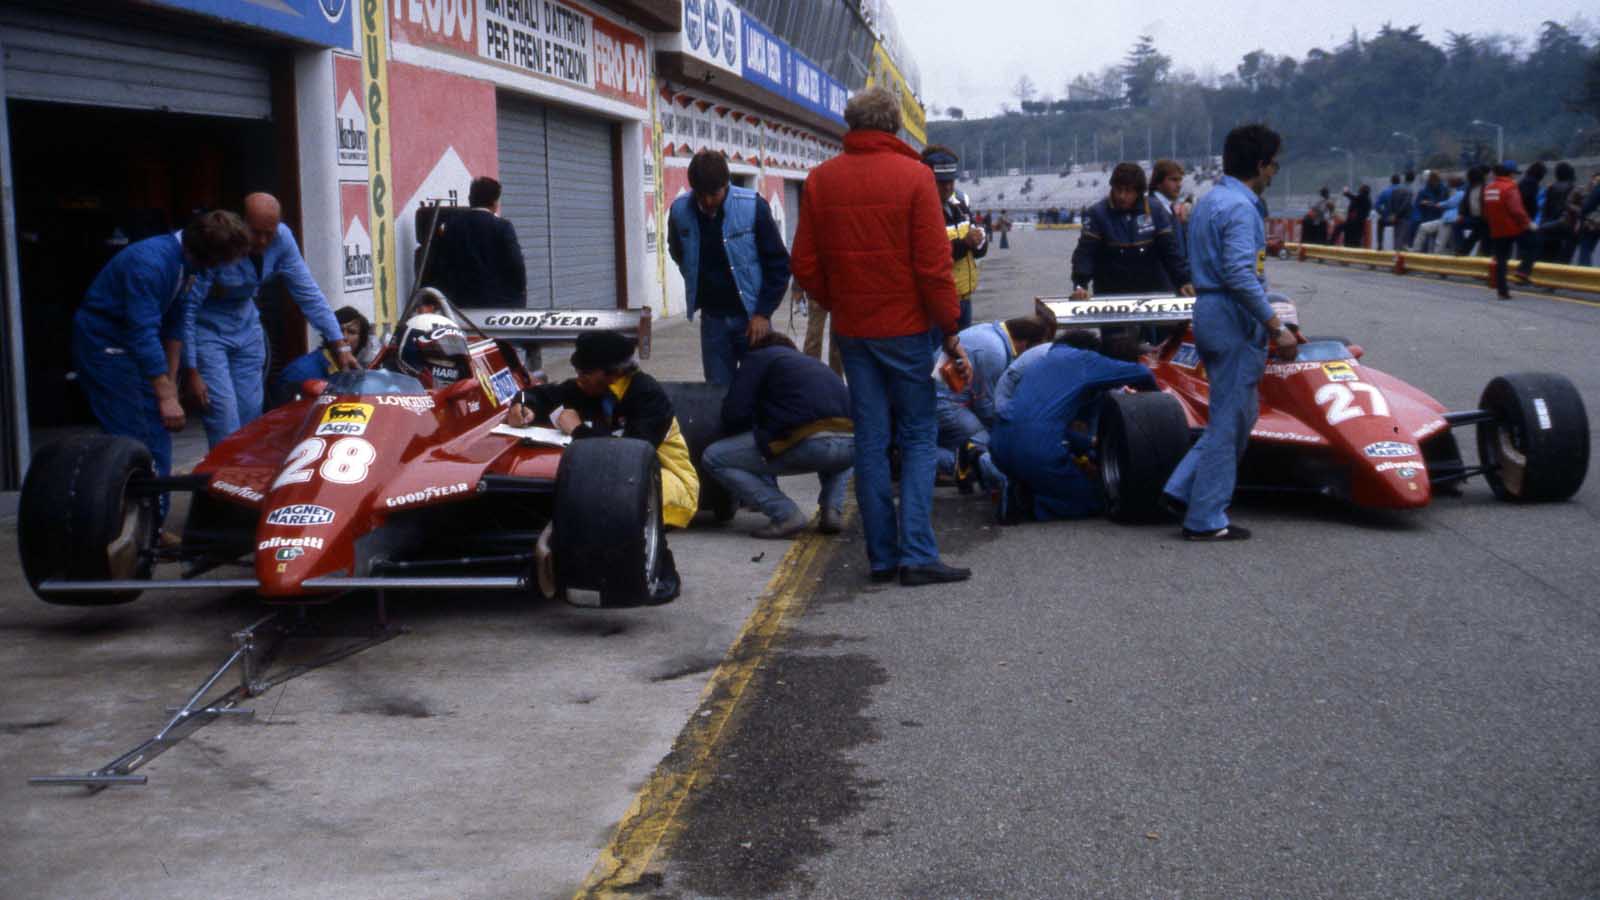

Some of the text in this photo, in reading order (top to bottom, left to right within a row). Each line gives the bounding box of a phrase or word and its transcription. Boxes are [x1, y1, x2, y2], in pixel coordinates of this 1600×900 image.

[487, 18, 588, 84] PER FRENI E FRIZIONI
[376, 395, 435, 408] LONGINES
[1314, 381, 1391, 427] 27
[321, 422, 362, 434] Agip
[270, 437, 377, 489] 28
[385, 482, 469, 508] GOODYEAR
[269, 505, 333, 520] MAGNETI
[269, 510, 333, 525] MARELLI
[258, 536, 324, 551] olivetti
